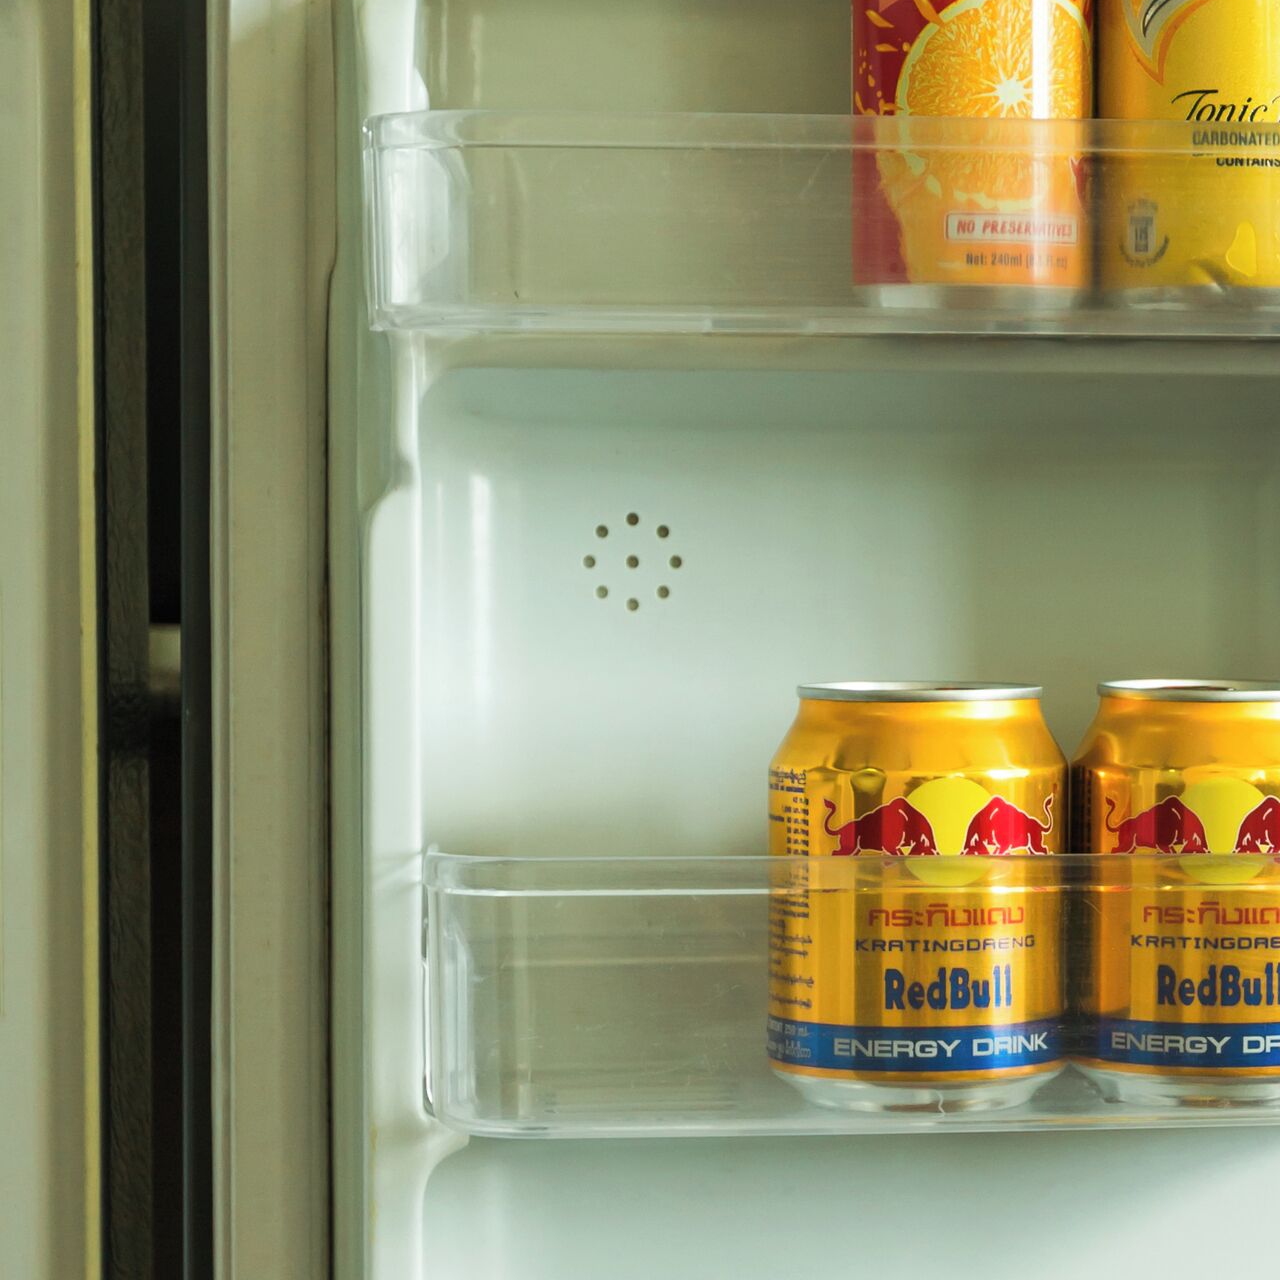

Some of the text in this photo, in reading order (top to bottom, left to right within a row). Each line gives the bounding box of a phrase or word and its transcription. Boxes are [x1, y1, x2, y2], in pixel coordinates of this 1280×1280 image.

[1171, 89, 1268, 123] Tonic
[1192, 131, 1280, 147] CARBONATED
[957, 220, 1072, 237] NO PRESERVATIVES
[966, 252, 987, 266] Net:
[991, 252, 1022, 267] 240ml
[855, 934, 1036, 952] KRATINGDAENG
[833, 1037, 961, 1058] ENERGY
[972, 1031, 1049, 1057] DRINK
[1111, 1031, 1231, 1054] ENERGY
